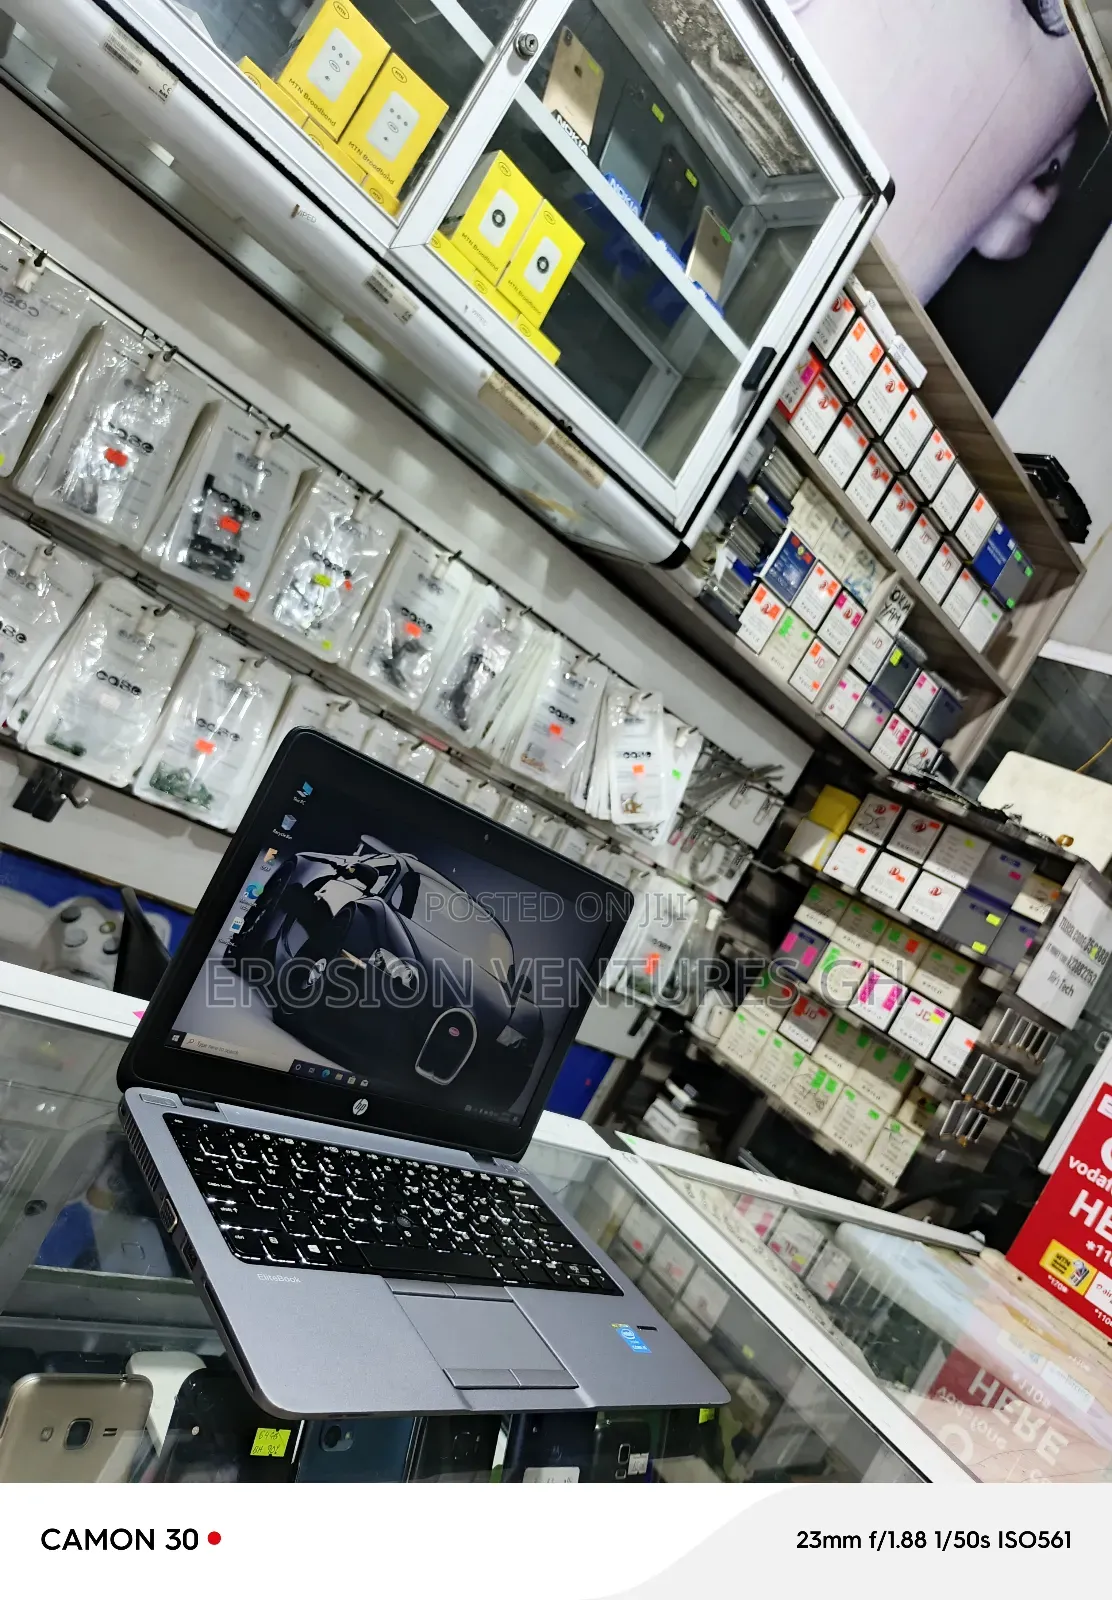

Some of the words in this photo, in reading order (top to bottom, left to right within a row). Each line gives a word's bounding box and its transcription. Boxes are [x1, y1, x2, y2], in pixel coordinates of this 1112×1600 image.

[288, 77, 303, 94] MTN
[302, 92, 337, 127] Broadband
[555, 113, 590, 156] NOKIA
[348, 140, 364, 156] MTN
[361, 151, 395, 185] Broadband
[609, 176, 640, 217] NOKIA
[461, 232, 473, 246] MTN
[400, 606, 434, 633] case
[95, 670, 143, 697] case
[548, 705, 576, 725] case
[1059, 978, 1074, 997] Tech
[257, 1273, 302, 1283] EliteBook
